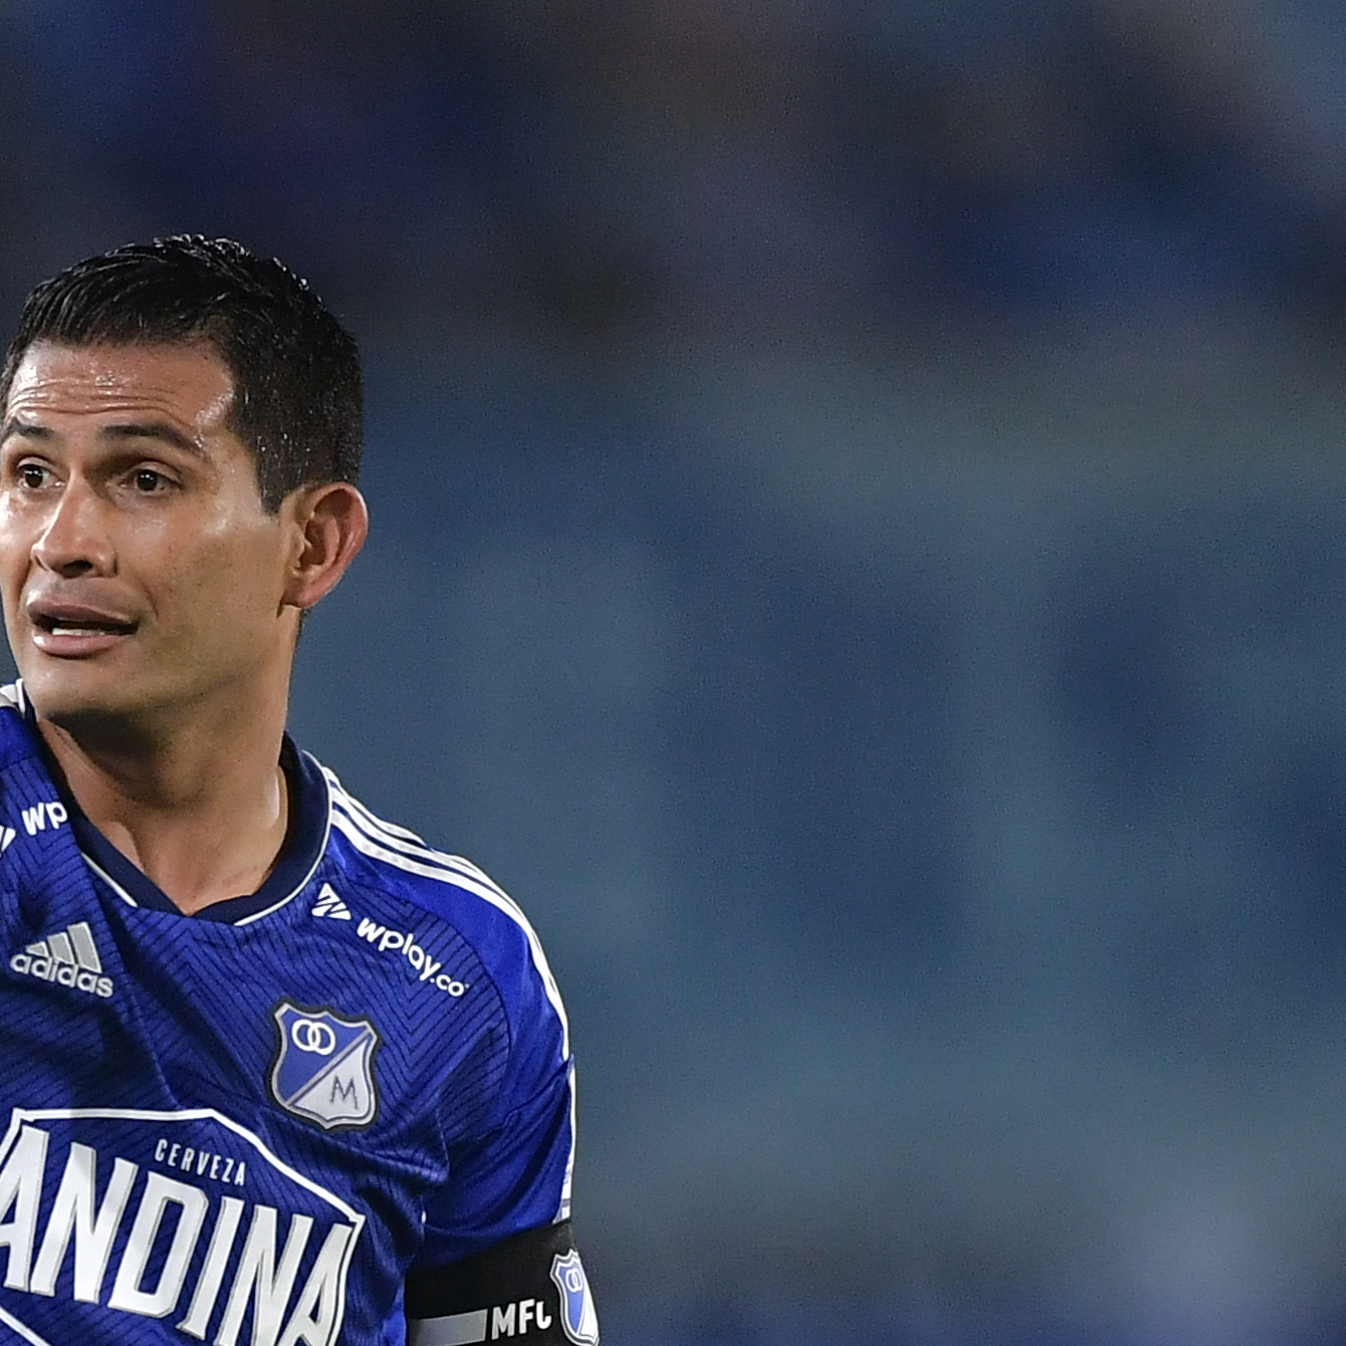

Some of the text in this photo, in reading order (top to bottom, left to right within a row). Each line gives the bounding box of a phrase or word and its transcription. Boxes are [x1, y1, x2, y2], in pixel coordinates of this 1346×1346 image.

[9, 953, 114, 998] adidas
[357, 917, 466, 997] wplay.co
[328, 1075, 359, 1110] M
[154, 1138, 246, 1187] CERVEZA
